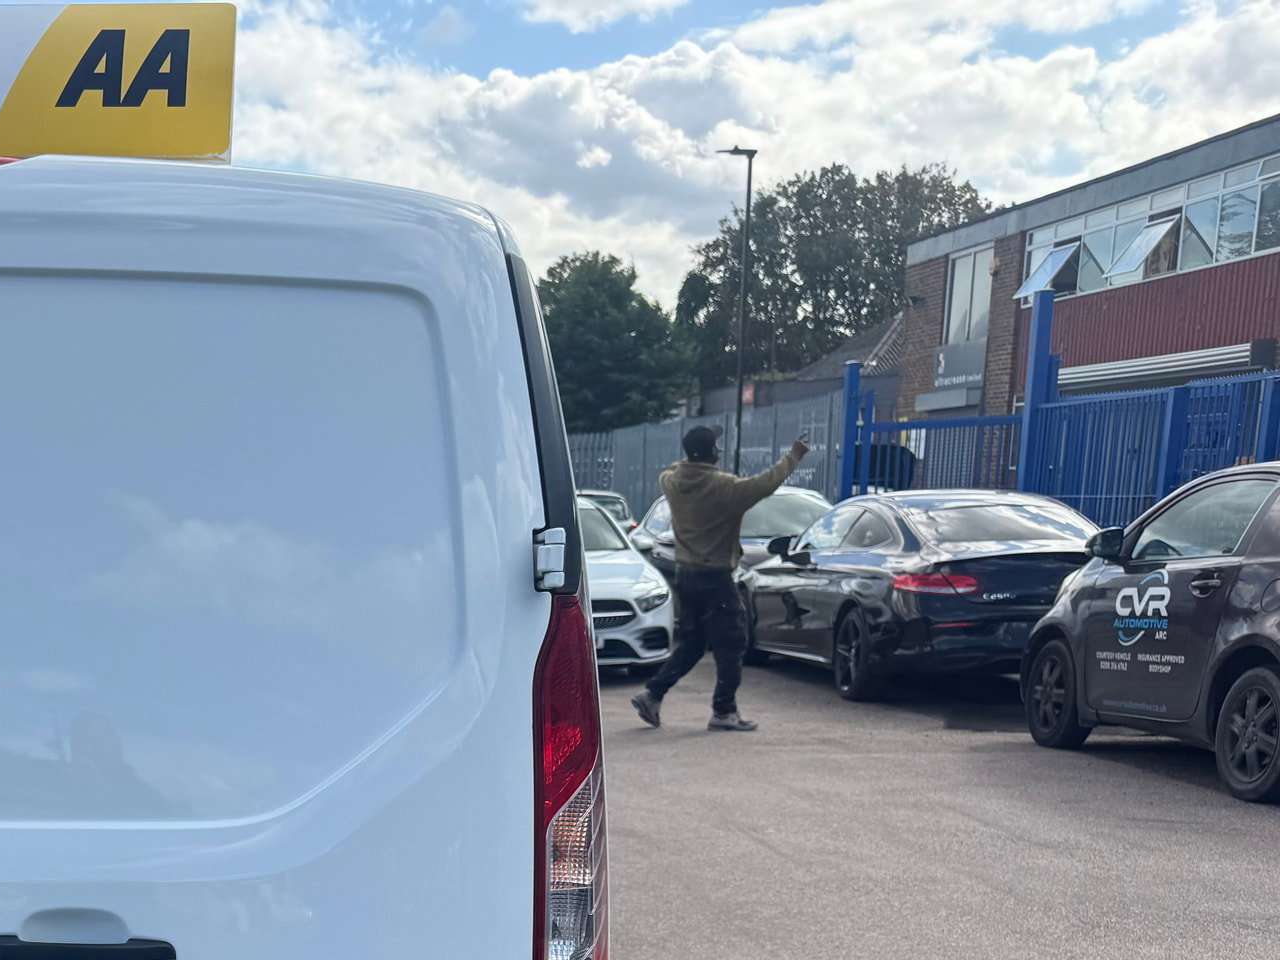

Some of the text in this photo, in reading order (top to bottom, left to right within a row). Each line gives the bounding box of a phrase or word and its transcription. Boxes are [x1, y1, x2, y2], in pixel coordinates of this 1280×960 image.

[55, 28, 191, 107] AA
[1116, 587, 1170, 616] CVR
[1113, 619, 1169, 629] AUTOMOTIVE
[1155, 631, 1168, 640] ARC
